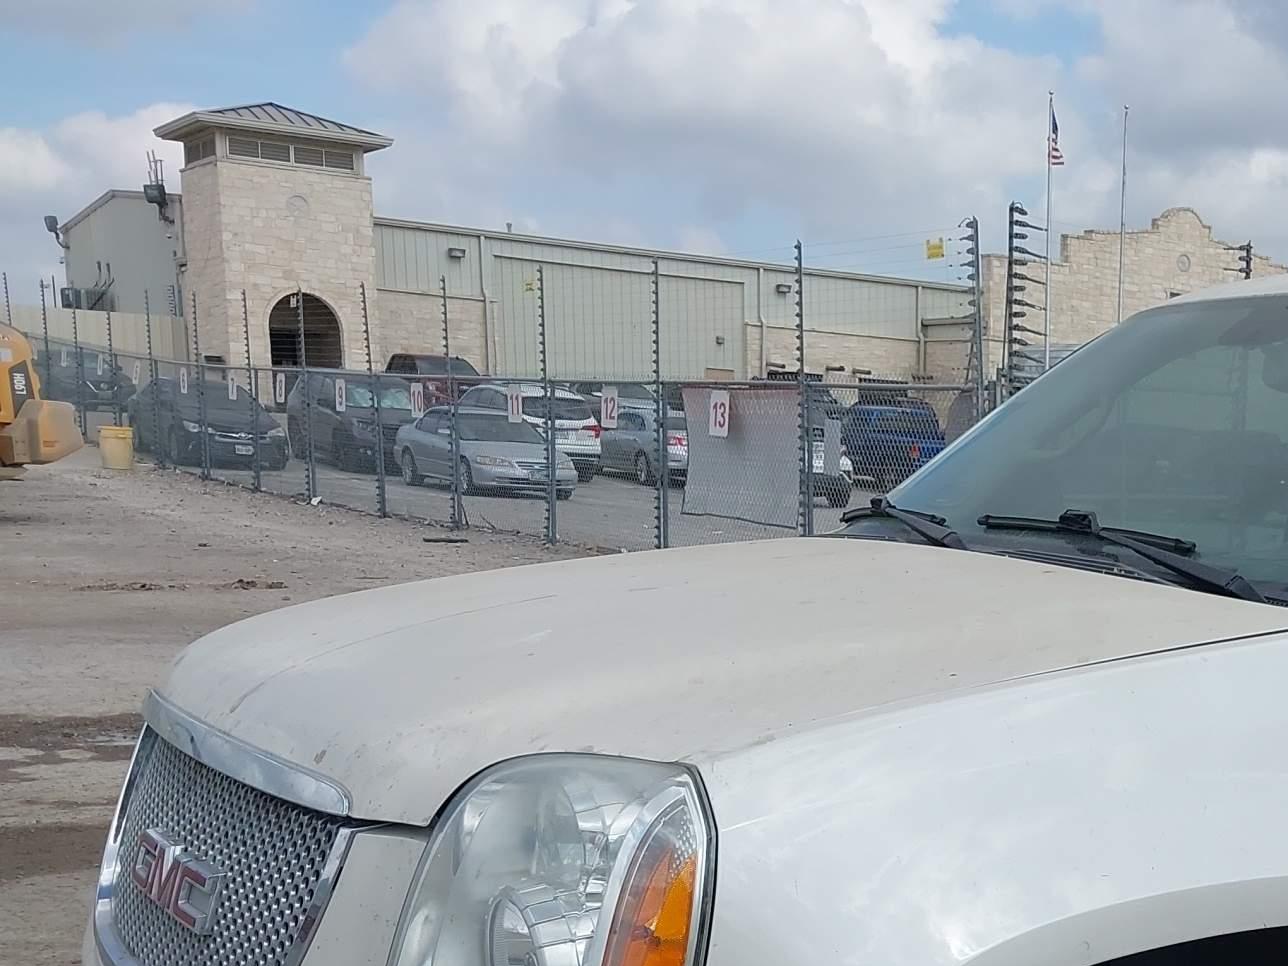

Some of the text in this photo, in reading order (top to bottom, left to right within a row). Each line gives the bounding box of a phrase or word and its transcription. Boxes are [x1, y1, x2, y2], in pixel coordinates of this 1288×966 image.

[12, 373, 27, 395] L90H
[338, 386, 343, 406] 9
[411, 390, 423, 412] 10
[509, 393, 520, 415] 11
[603, 396, 616, 420] 12
[712, 401, 727, 428] 13
[131, 829, 214, 935] GMC
